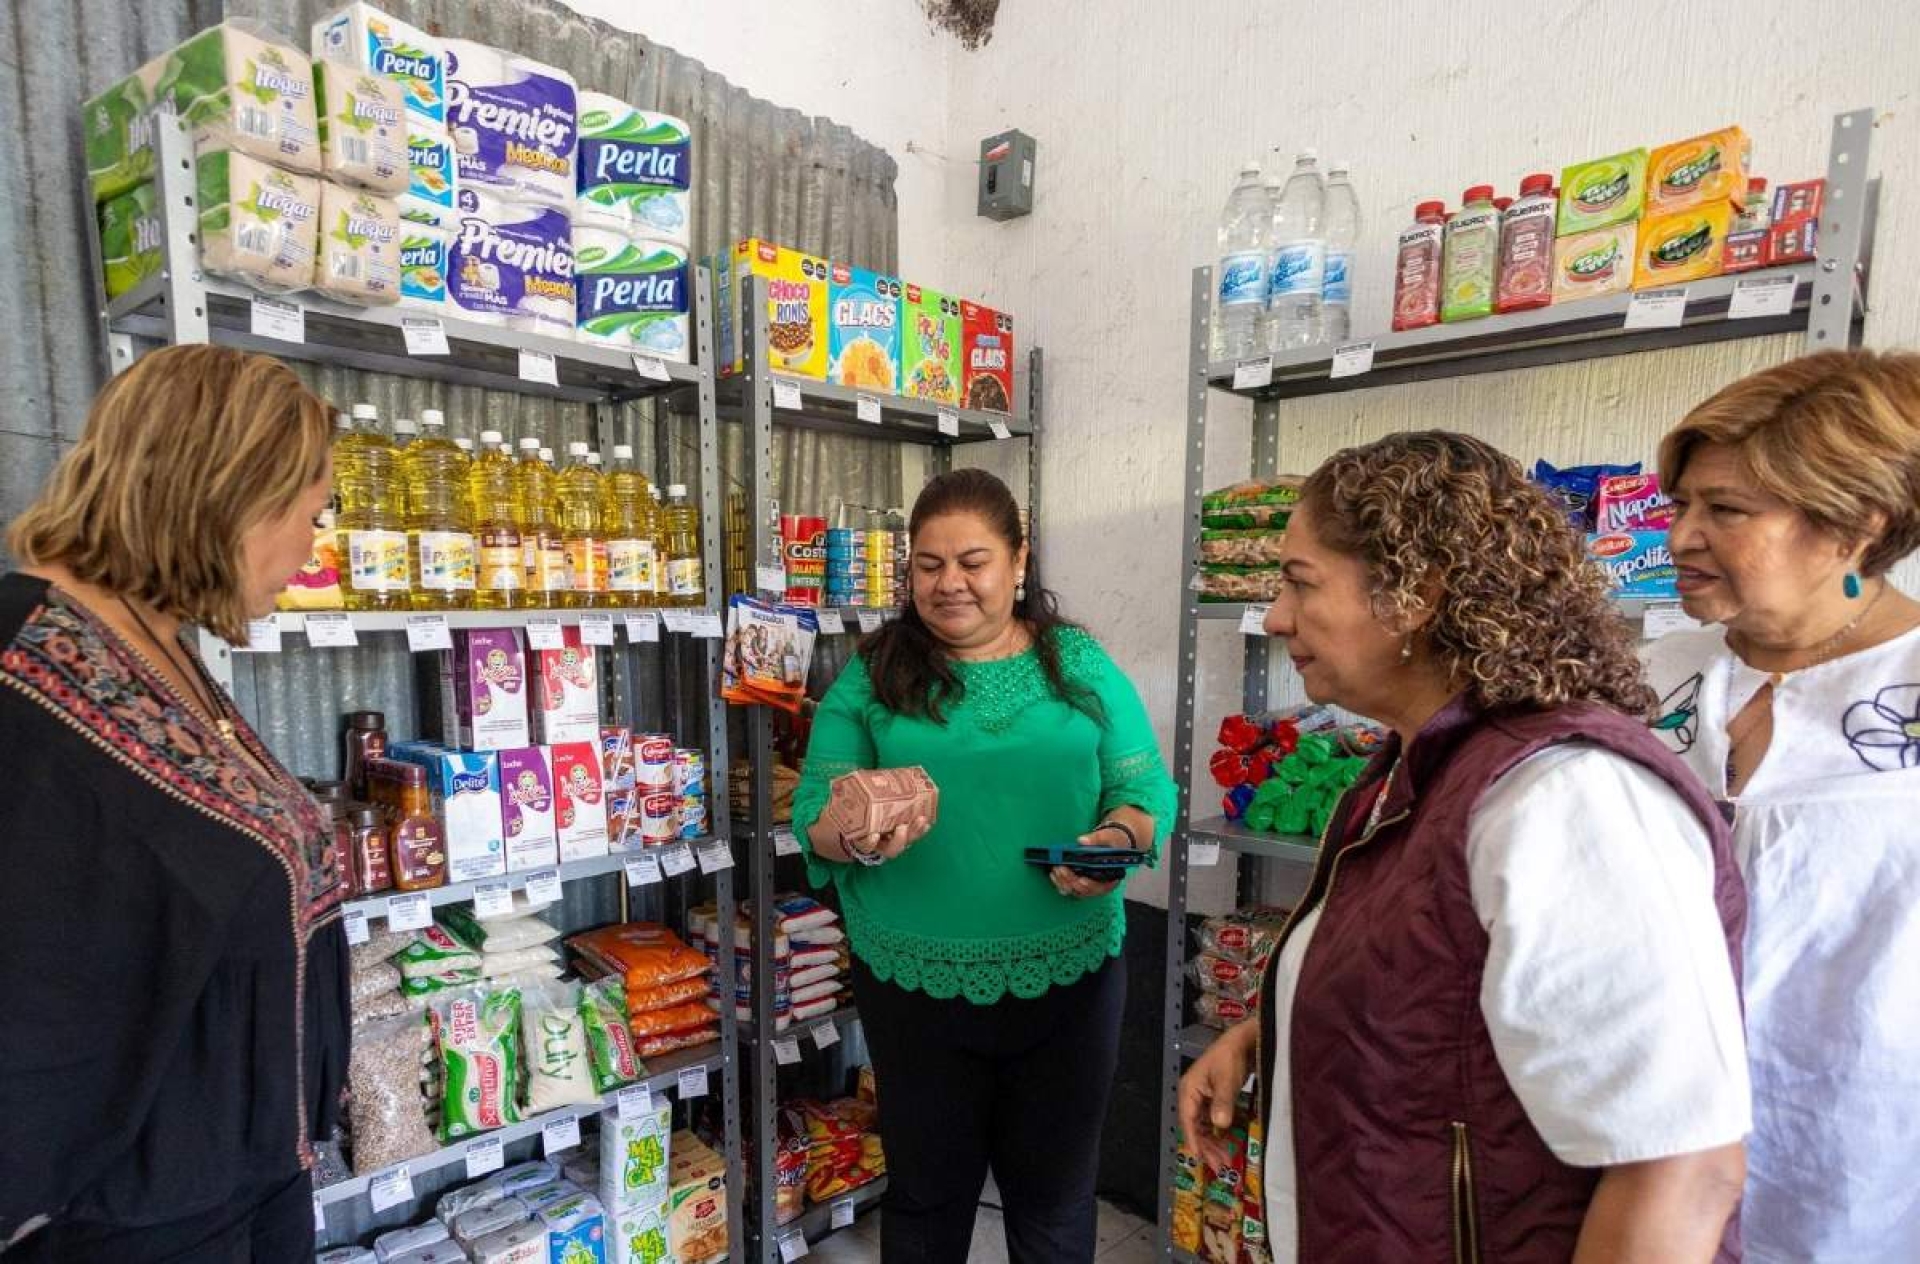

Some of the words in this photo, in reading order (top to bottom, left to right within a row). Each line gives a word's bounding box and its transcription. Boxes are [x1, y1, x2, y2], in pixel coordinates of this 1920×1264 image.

[383, 52, 430, 78] Perla
[447, 81, 571, 147] Premier
[408, 147, 440, 166] erla
[596, 143, 677, 179] Perla
[400, 249, 437, 265] erla
[594, 274, 675, 311] Perla
[776, 302, 810, 324] RONIS
[1608, 488, 1666, 529] Napol
[452, 1001, 464, 1046] SUPER
[465, 1003, 476, 1040] EXTRA
